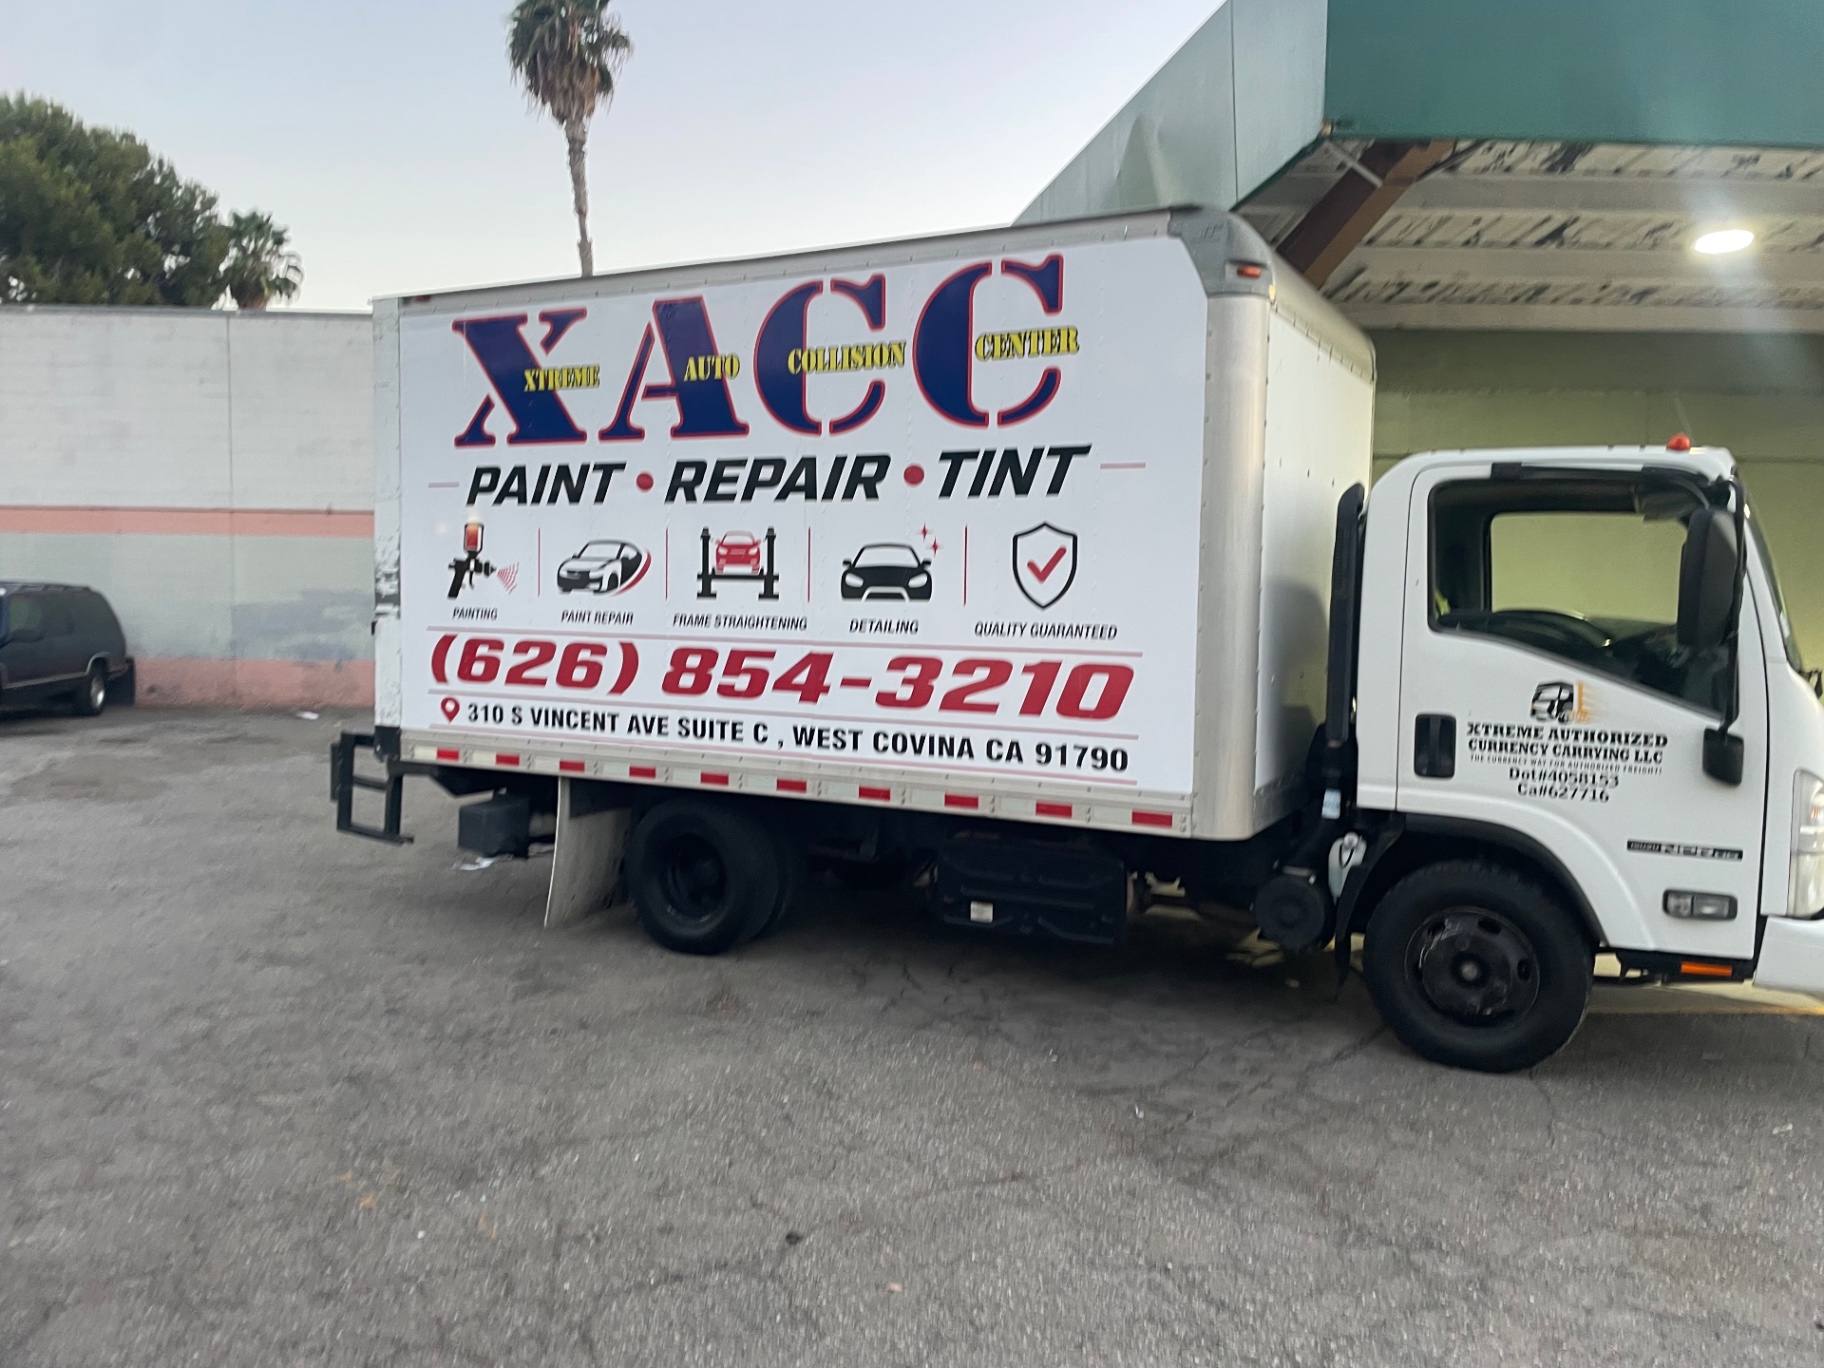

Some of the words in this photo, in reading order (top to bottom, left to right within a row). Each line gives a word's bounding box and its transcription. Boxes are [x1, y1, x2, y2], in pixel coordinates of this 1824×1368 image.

[452, 253, 1064, 448] XACC
[524, 364, 600, 392] XTREME
[683, 353, 740, 382] AUTO
[787, 340, 906, 374] COLLISION
[975, 325, 1080, 361] CENTER
[465, 461, 627, 506] PAINT
[664, 453, 891, 504] REPAIR
[938, 443, 1092, 499] TINT
[453, 606, 498, 621] PAINTING
[561, 610, 591, 624] PAINT
[594, 611, 634, 625] REPAIR
[673, 613, 711, 628] FRAME
[714, 614, 808, 631] STRAIGHTENING
[849, 618, 919, 635] DETAILING
[974, 621, 1027, 638] QUALITY
[1030, 623, 1118, 641] GUARANTEED
[431, 633, 640, 695] (626)
[661, 646, 1135, 721] 854-3210
[468, 703, 504, 724] 310
[511, 706, 522, 725] S
[530, 707, 619, 734] VINCENT
[627, 715, 669, 738] AVE
[677, 718, 744, 743] SUITE
[753, 723, 769, 744] C
[792, 726, 863, 752] WEST
[872, 731, 975, 761] COVINA
[985, 739, 1023, 764] CA
[1035, 744, 1128, 772] 91790
[1467, 722, 1544, 740] XTREME
[1549, 728, 1668, 748] AUTHORIZED
[1468, 739, 1548, 756] CURRENCY
[1552, 744, 1630, 762] CARRYING
[1634, 749, 1663, 764] LLC
